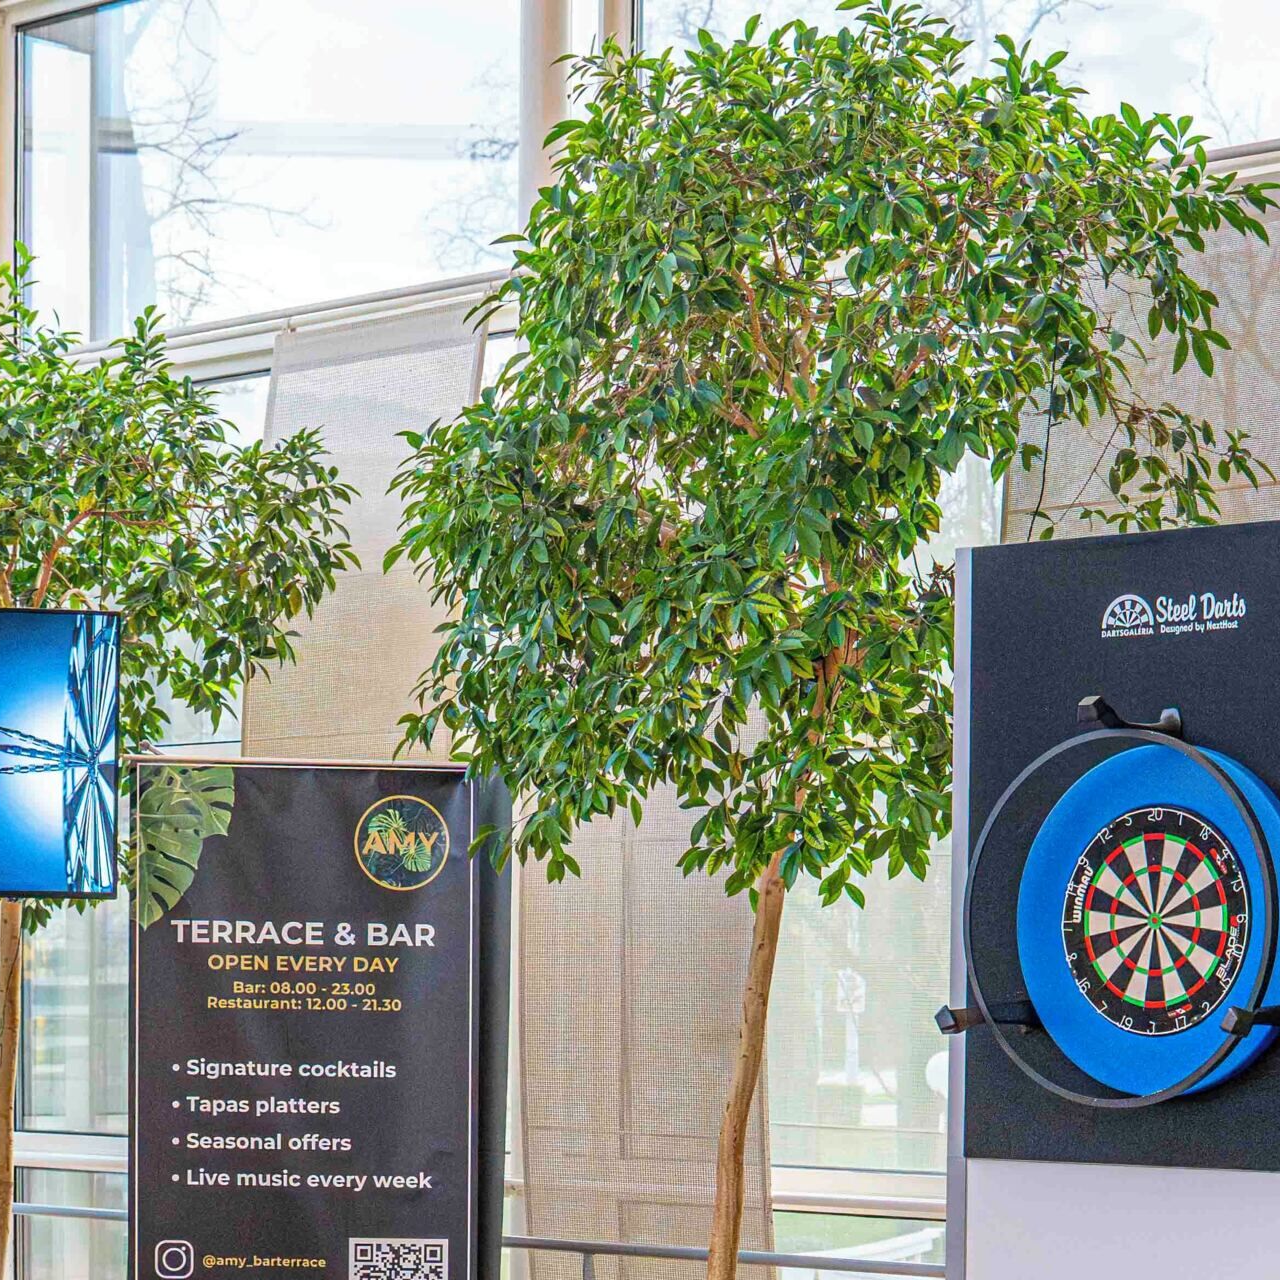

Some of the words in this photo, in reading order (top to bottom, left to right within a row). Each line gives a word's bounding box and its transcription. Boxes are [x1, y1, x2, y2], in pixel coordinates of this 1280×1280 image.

[1155, 594, 1197, 623] Steel
[1200, 592, 1246, 620] Darts
[1160, 622, 1194, 635] Designed
[1195, 621, 1205, 633] by
[1148, 808, 1163, 822] 20
[362, 831, 439, 855] AMY
[1098, 827, 1113, 844] 12
[170, 919, 324, 945] TERRACE
[334, 922, 356, 946] &
[367, 923, 436, 947] BAR
[207, 954, 269, 971] OPEN
[276, 956, 348, 972] EVERY
[353, 957, 400, 973] DAY
[233, 982, 266, 994] Bar:
[270, 982, 316, 995] 08.00
[332, 983, 376, 996] 23.00
[207, 996, 302, 1010] Restaurant:
[306, 997, 348, 1011] 12.00
[362, 999, 402, 1012] 21.30
[186, 1058, 293, 1080] Signature
[298, 1061, 396, 1079] cocktails
[186, 1096, 249, 1116] Tapas
[255, 1097, 341, 1117] platters
[186, 1133, 282, 1151] Seasonal
[288, 1134, 352, 1151] offers
[187, 1168, 231, 1186] Live
[236, 1169, 301, 1188] music
[306, 1173, 367, 1191] every
[373, 1171, 432, 1189] week
[202, 1254, 327, 1269] @amy_barterrace
